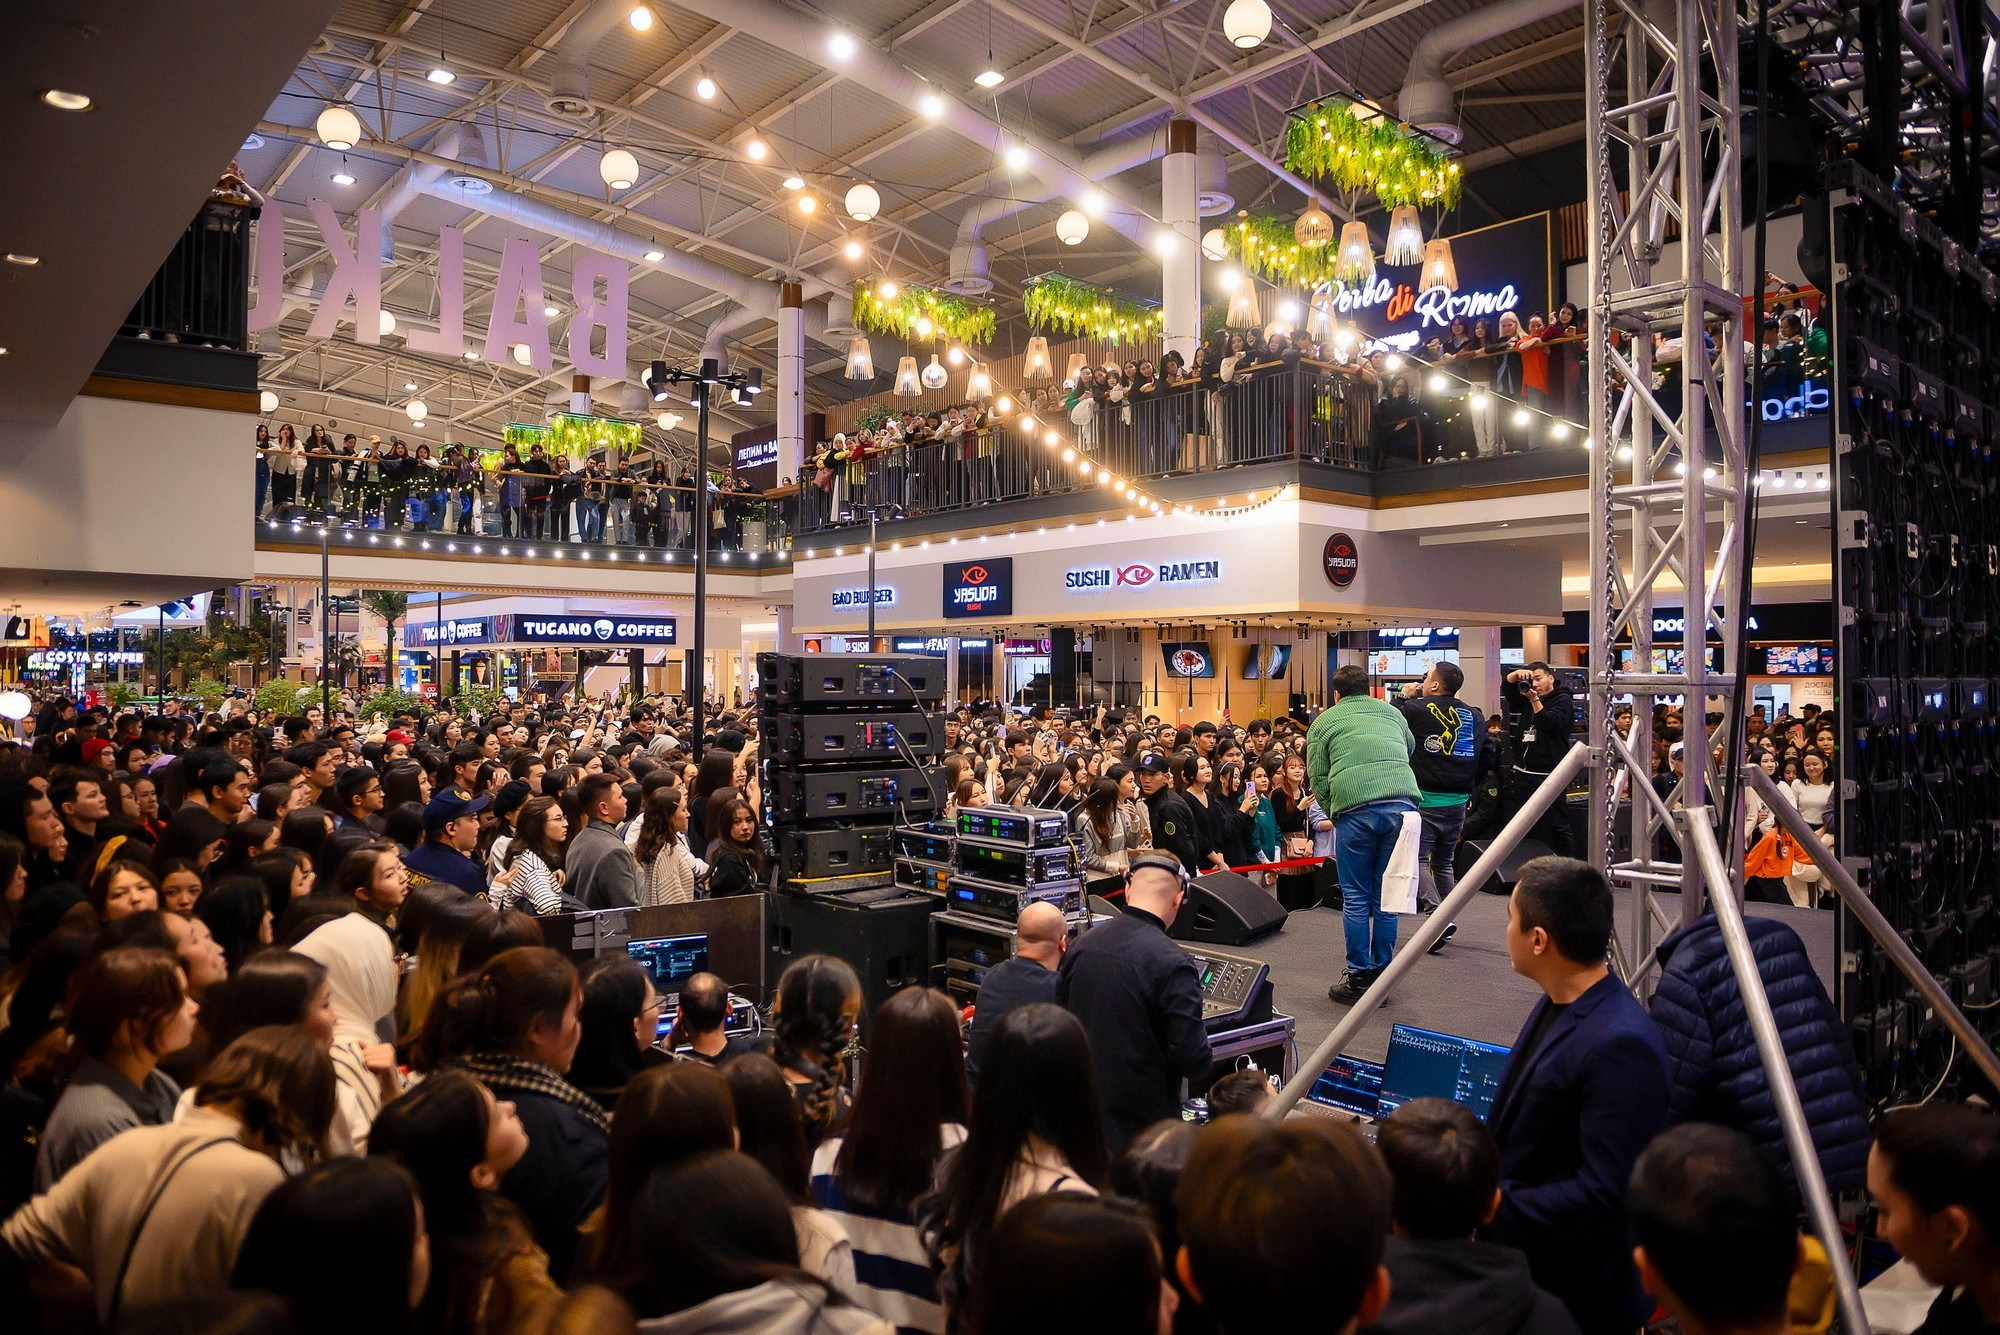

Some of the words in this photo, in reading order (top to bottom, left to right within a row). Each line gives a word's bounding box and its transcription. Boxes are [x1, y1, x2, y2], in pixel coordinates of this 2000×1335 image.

[1386, 284, 1415, 322] di
[738, 444, 762, 461] ЛЕПИМ
[1066, 570, 1110, 588] SUSHI
[1159, 561, 1219, 582] RAMEN
[832, 593, 852, 605] BAO
[853, 589, 892, 604] BUGER
[954, 585, 997, 603] YASUDA
[967, 603, 981, 611] SUSHI
[456, 622, 482, 639] COFFEE
[523, 622, 592, 636] TUCANO
[617, 624, 673, 637] COFFEE
[45, 651, 91, 663] COSTA
[94, 651, 144, 663] COFFEE
